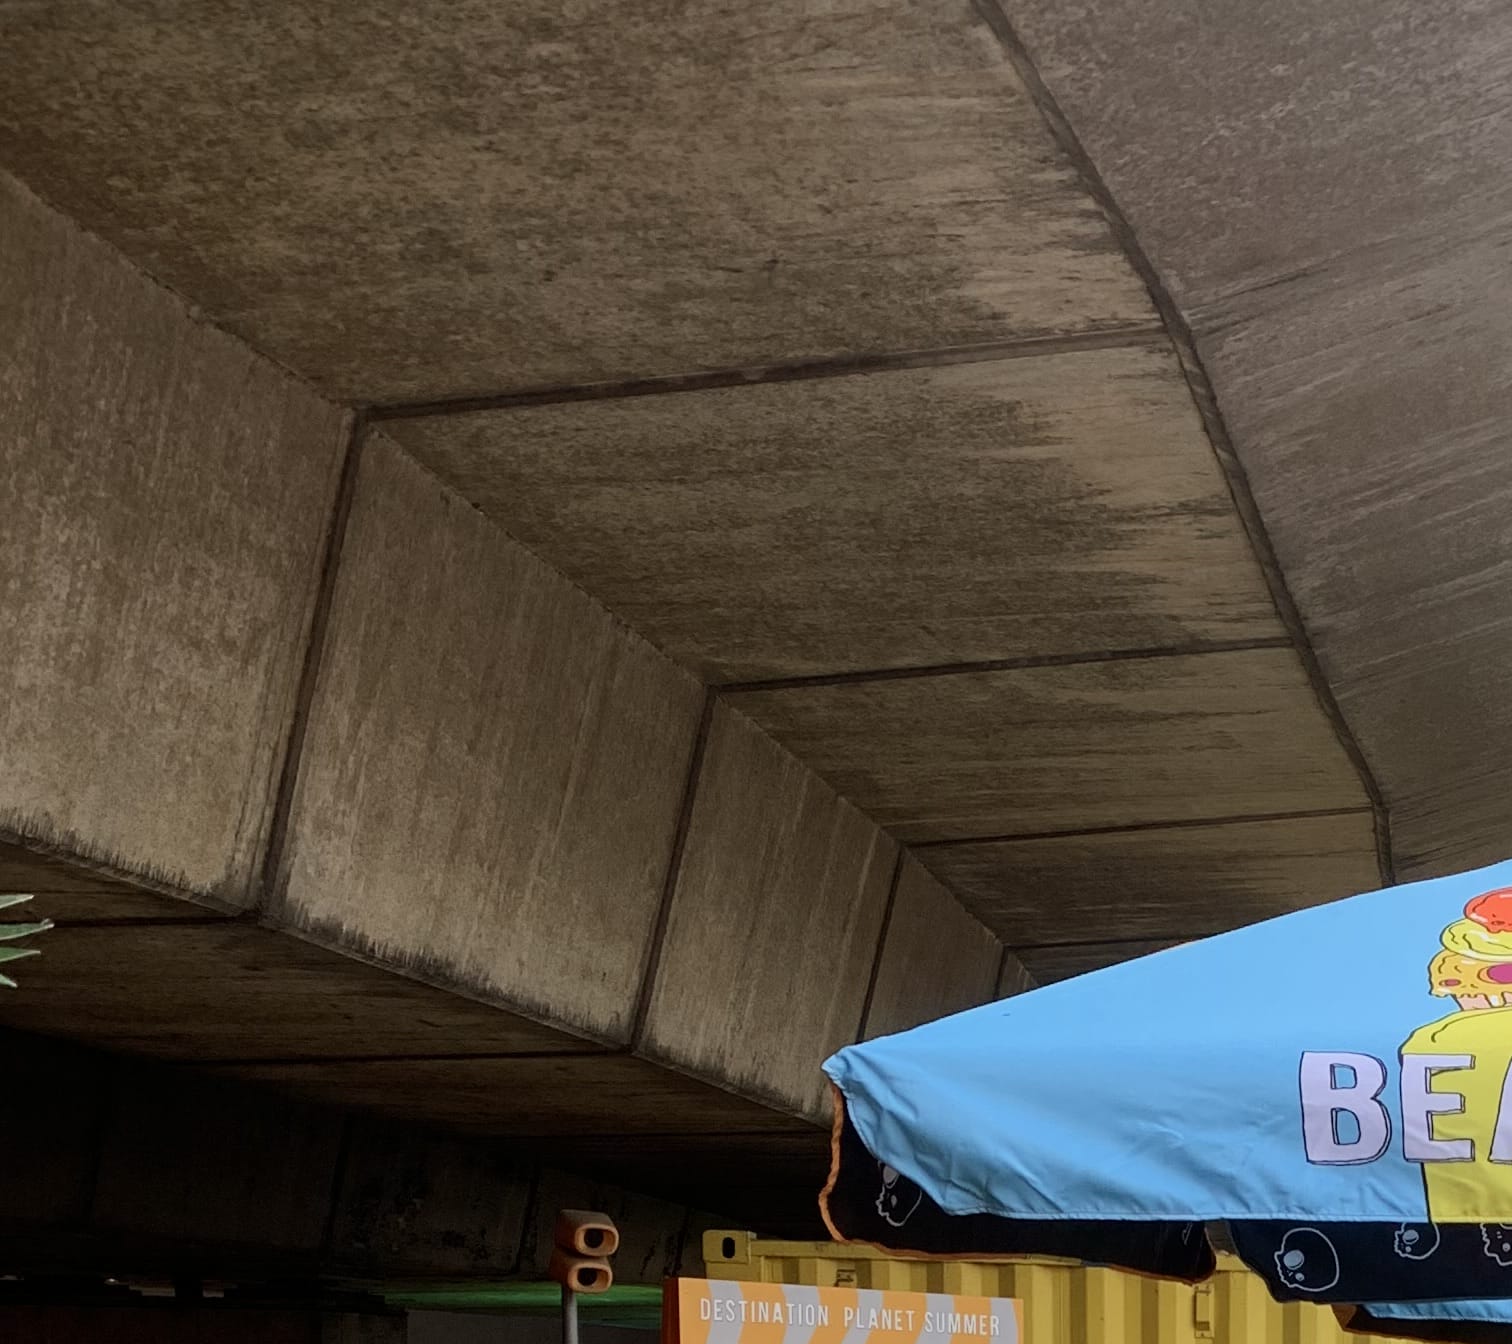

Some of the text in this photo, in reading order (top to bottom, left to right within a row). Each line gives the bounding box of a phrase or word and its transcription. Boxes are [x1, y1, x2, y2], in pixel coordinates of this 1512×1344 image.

[700, 1299, 1000, 1336] DESTINATION PLANET SUMMER
